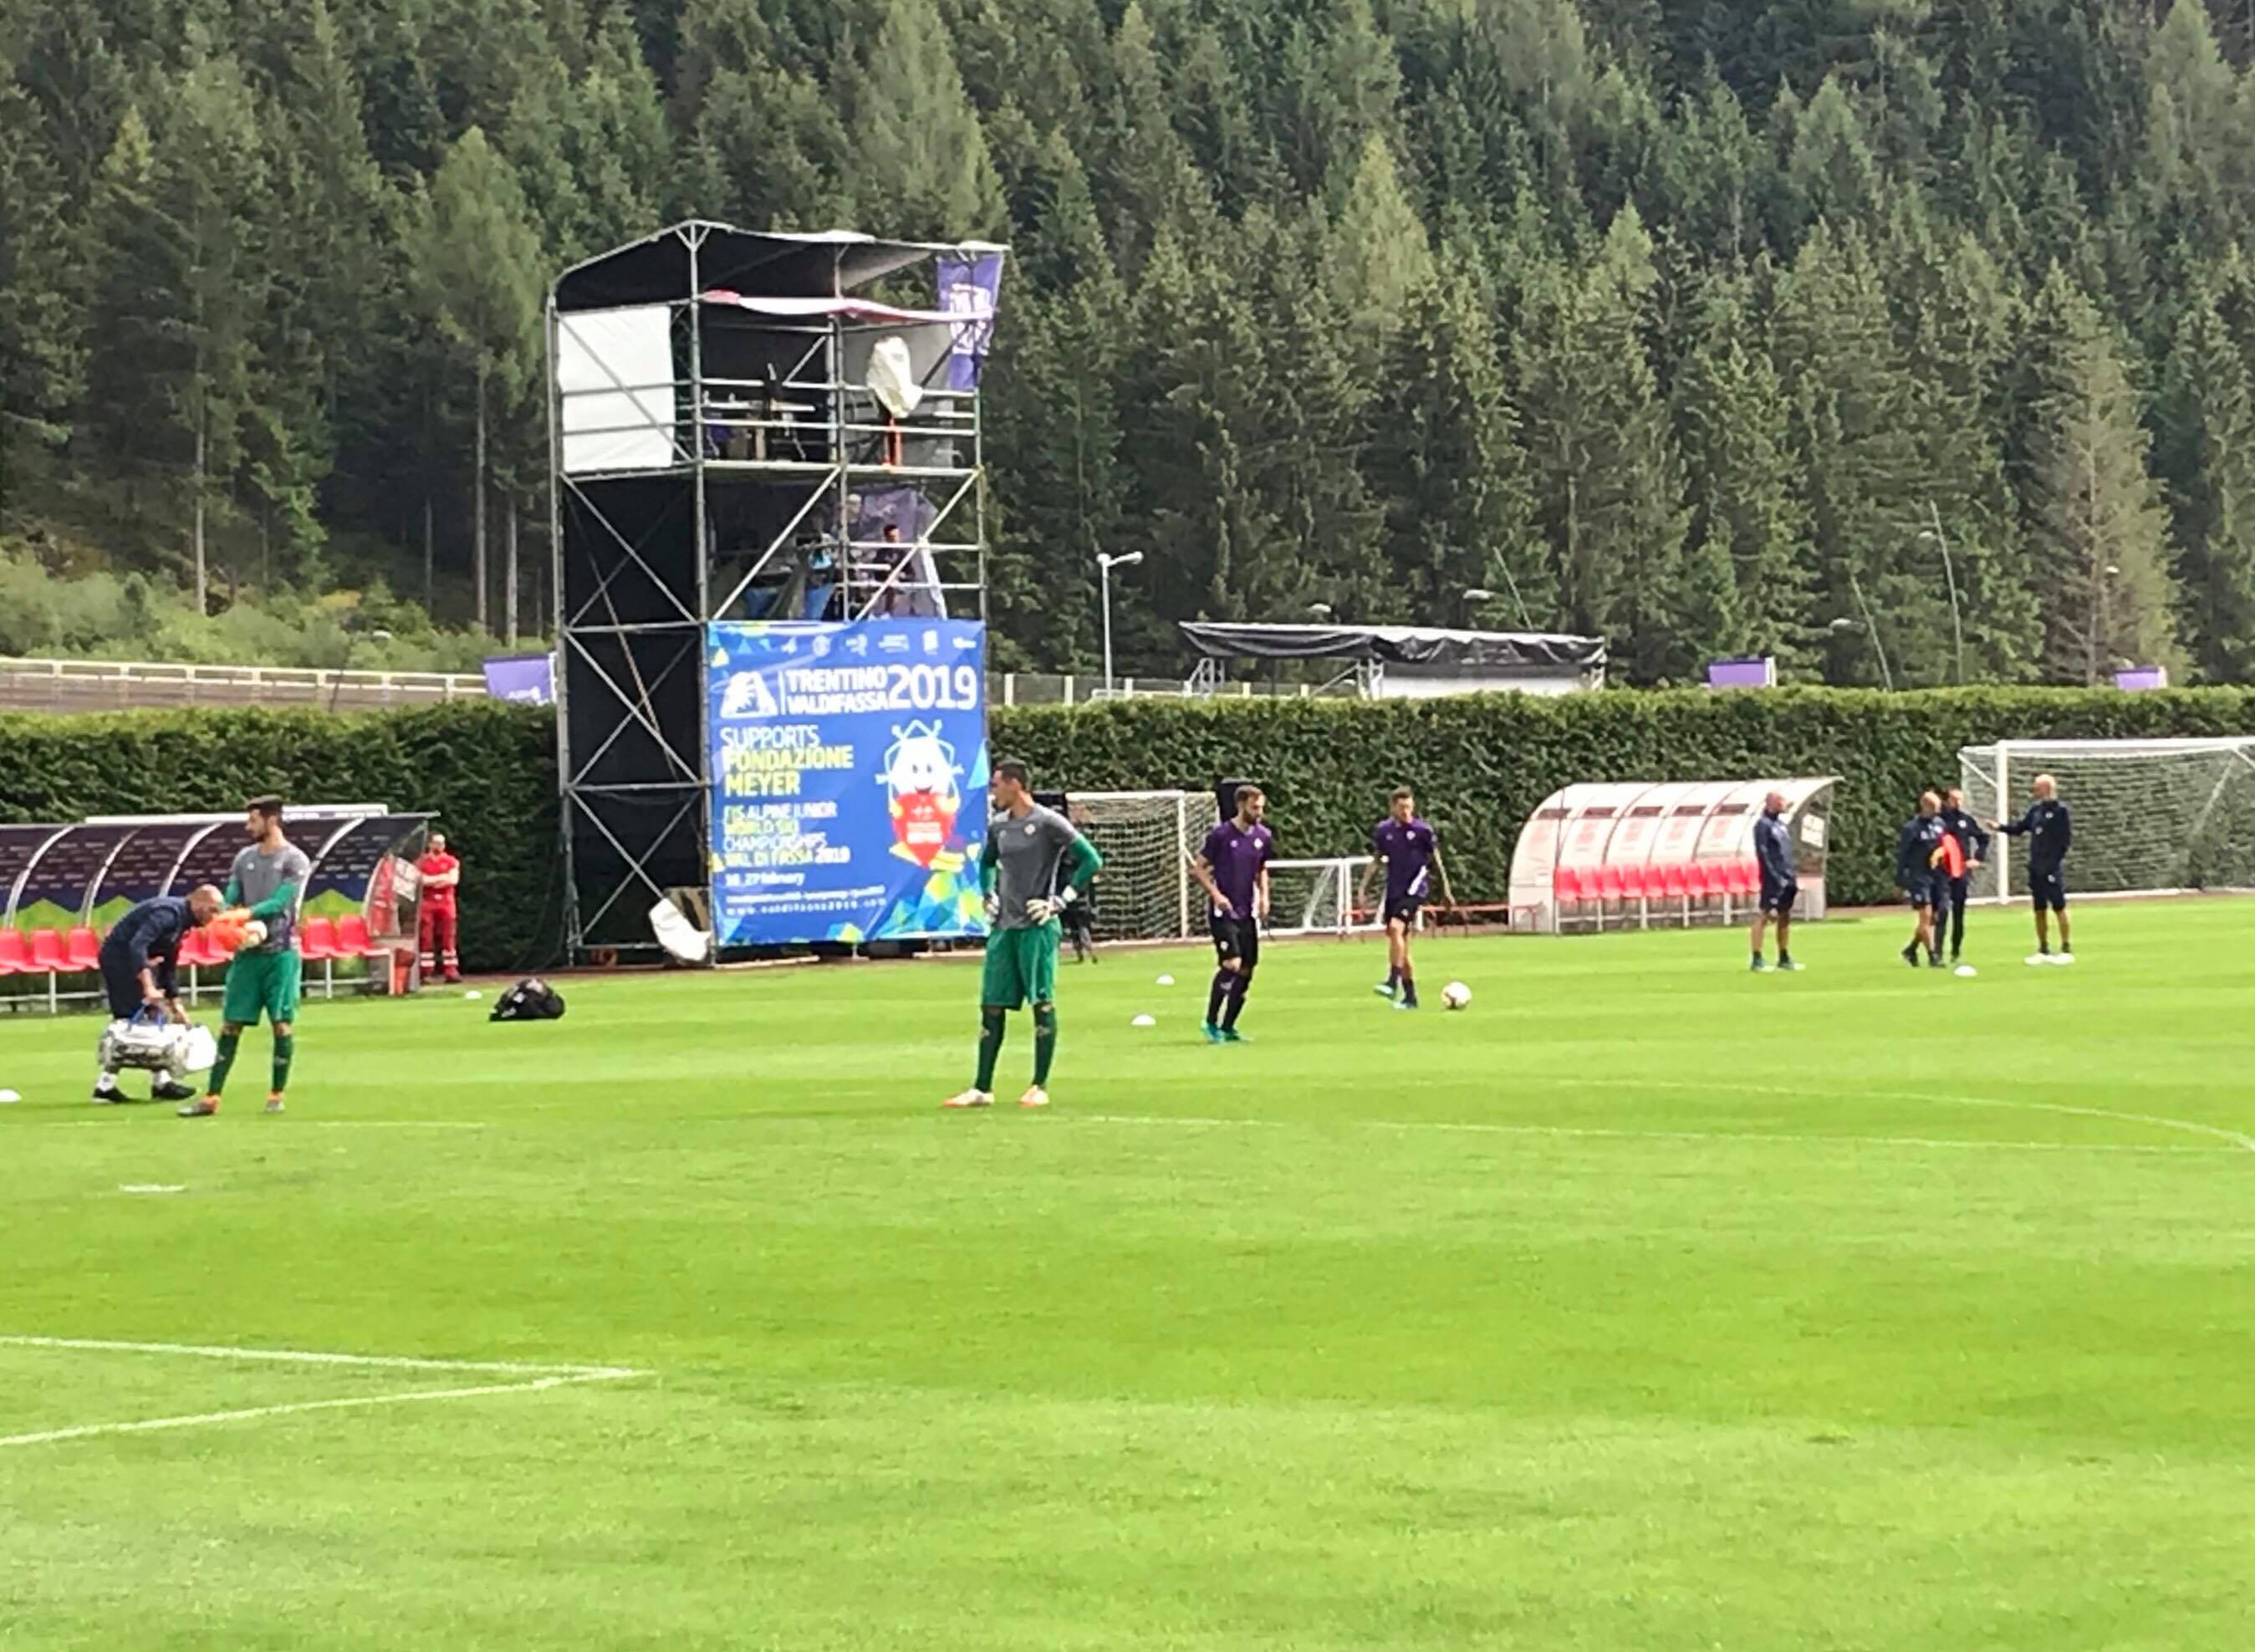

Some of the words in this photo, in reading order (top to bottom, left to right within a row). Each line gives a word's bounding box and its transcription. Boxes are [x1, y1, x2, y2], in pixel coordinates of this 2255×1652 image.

[785, 665, 888, 693] TRENTINO
[886, 664, 977, 711] 2019
[719, 724, 821, 751] SUPPORTS
[722, 744, 855, 772] FONDAZIONE
[724, 771, 801, 798] MEYER
